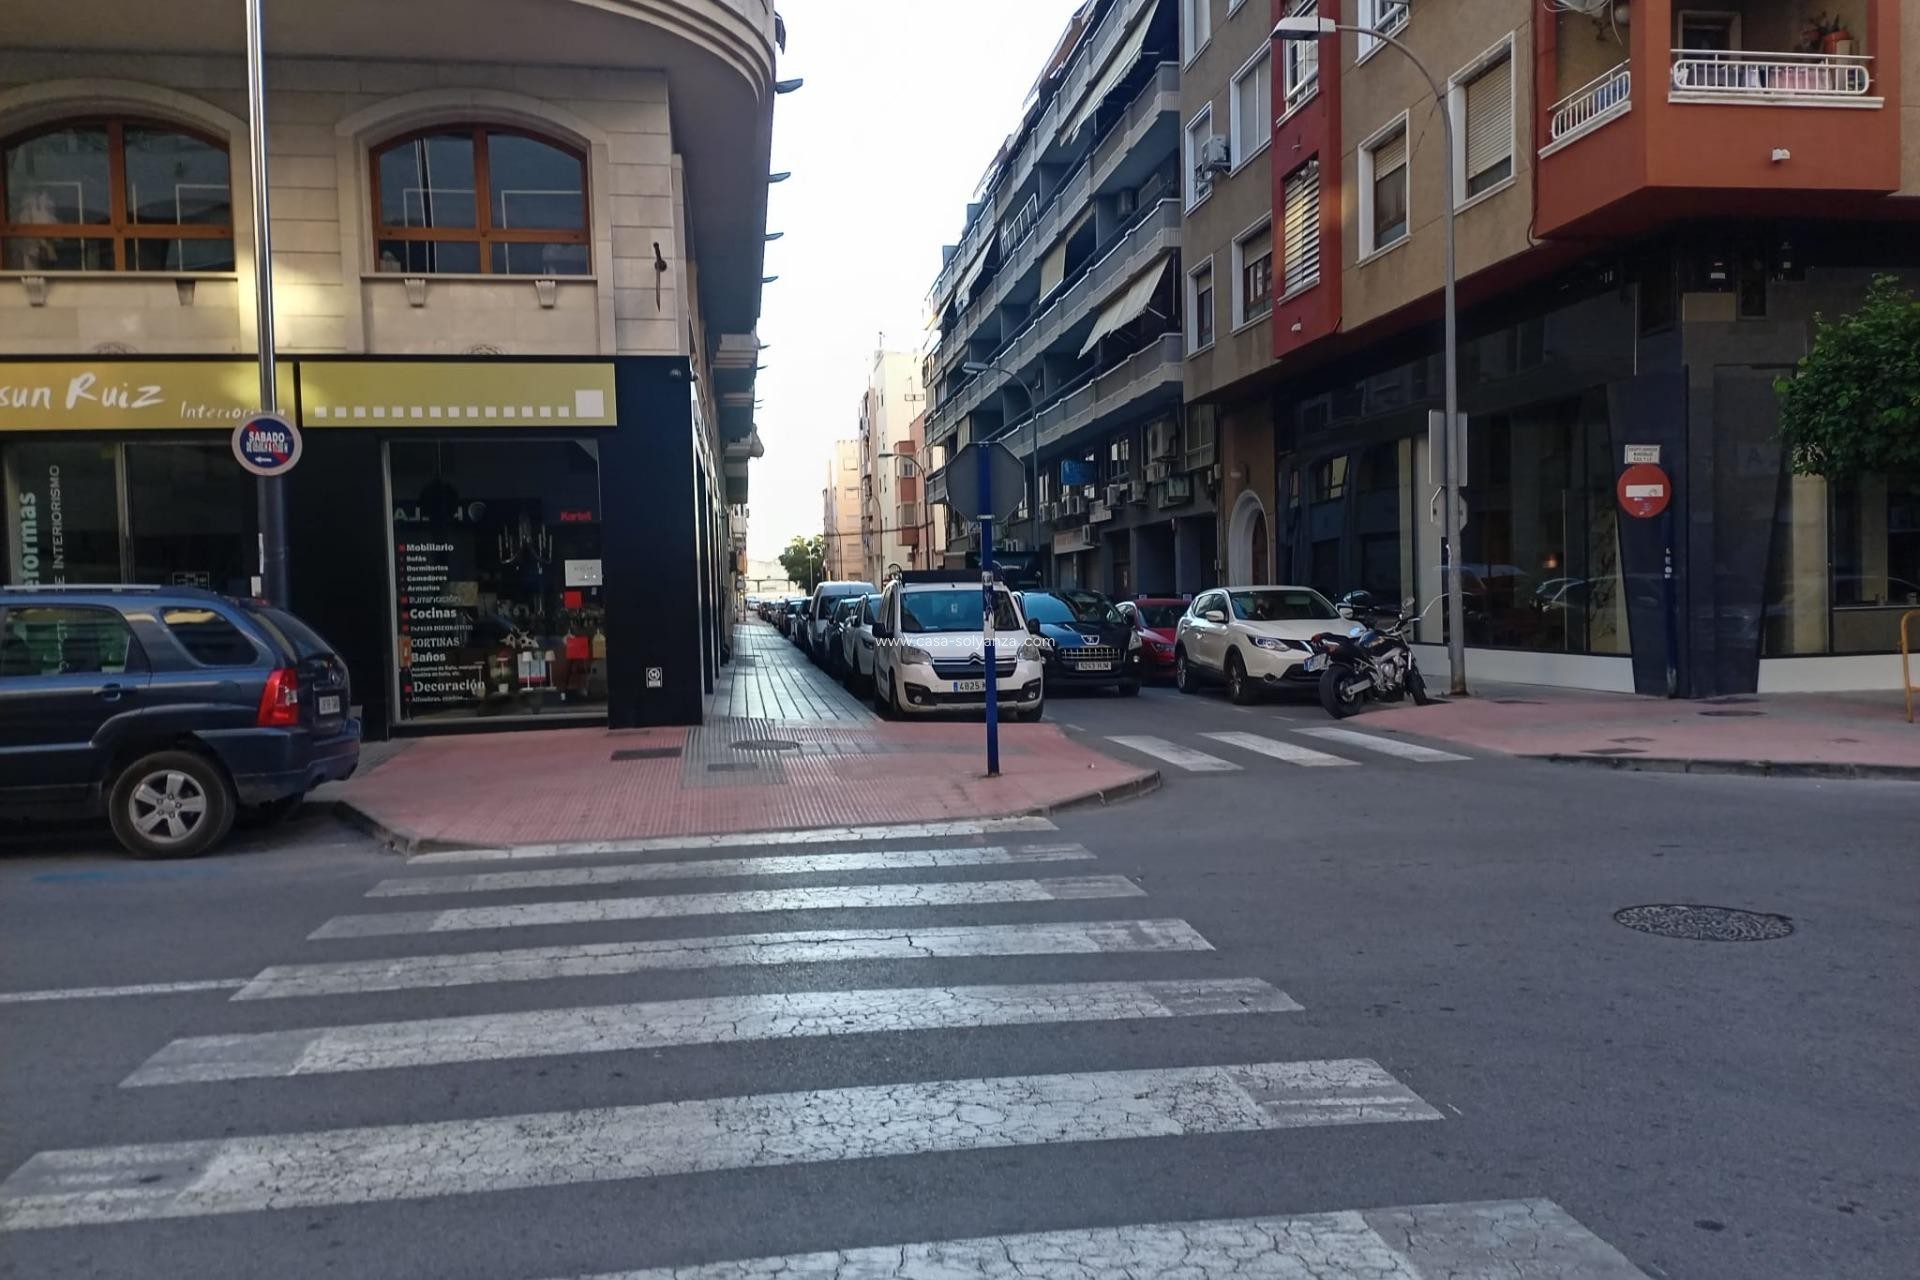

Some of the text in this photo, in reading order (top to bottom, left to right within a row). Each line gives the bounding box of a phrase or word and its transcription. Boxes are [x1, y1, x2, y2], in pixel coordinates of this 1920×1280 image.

[66, 371, 167, 410] Ruiz
[248, 431, 285, 442] SABADO
[49, 465, 65, 569] INTERIORISMO
[406, 543, 454, 552] Mobiliario
[409, 607, 457, 620] Cocinas
[410, 636, 460, 648] CORTINAS
[411, 651, 446, 662] Baños
[413, 679, 486, 693] Decoración
